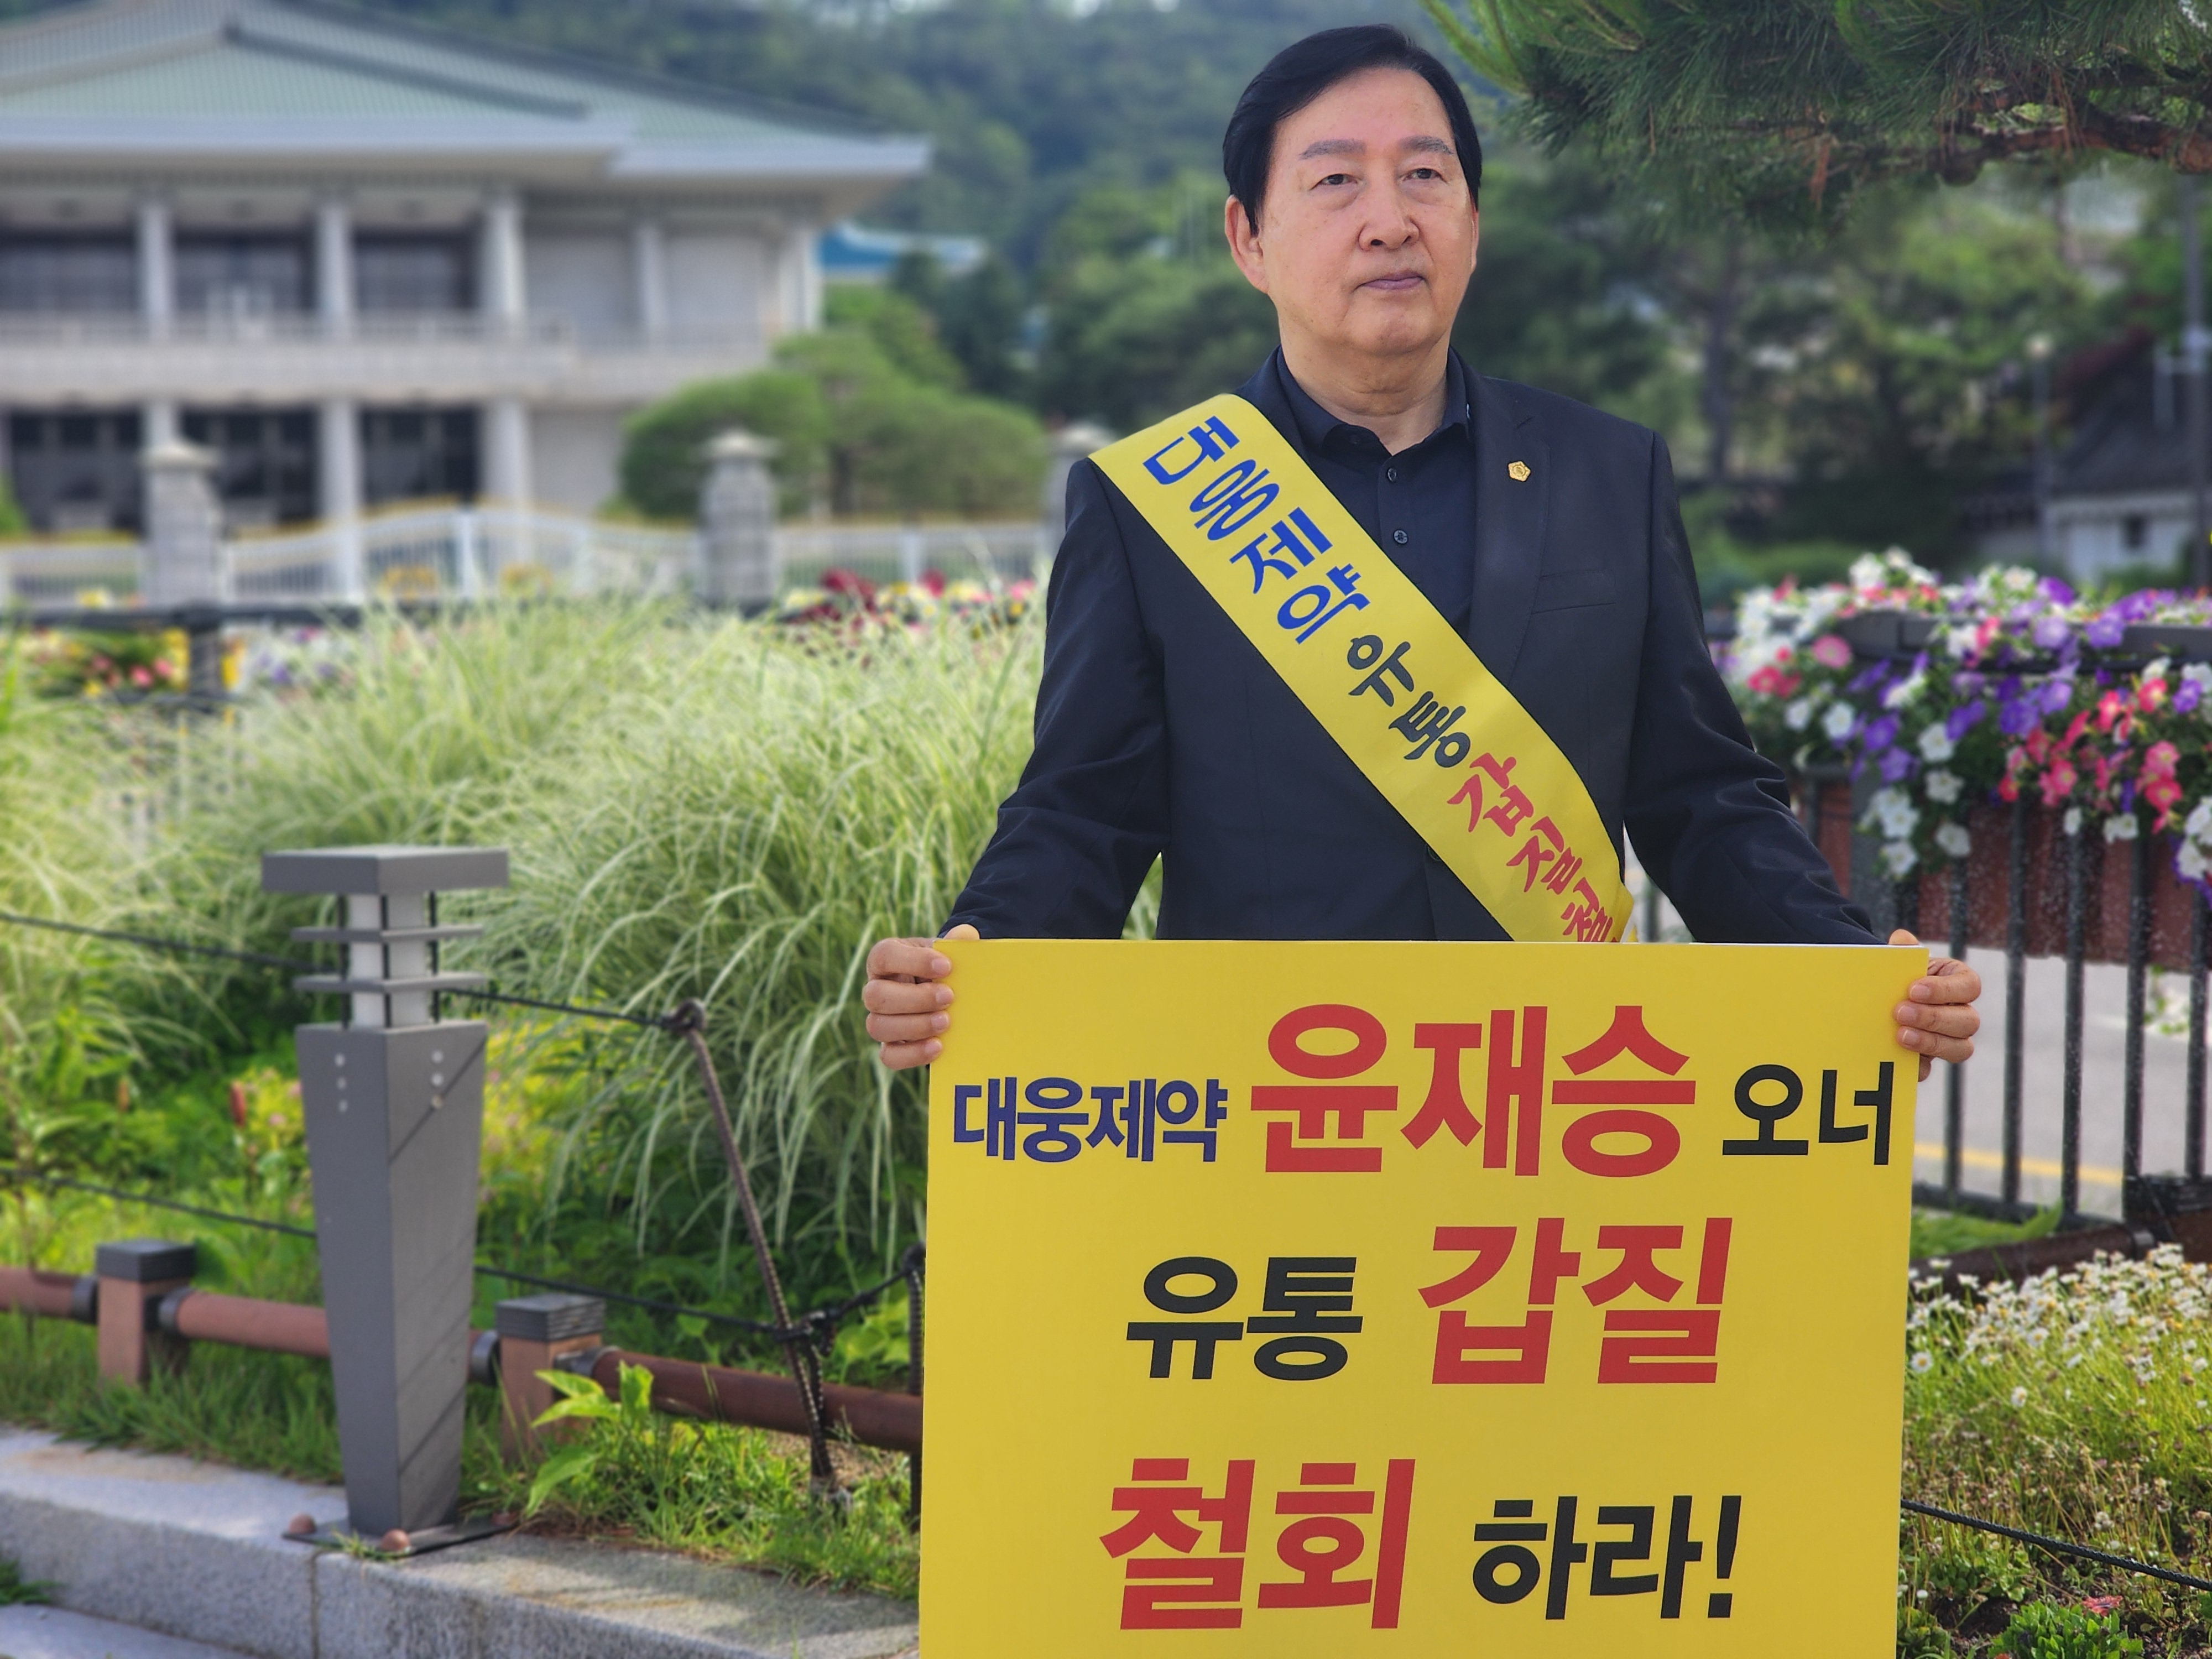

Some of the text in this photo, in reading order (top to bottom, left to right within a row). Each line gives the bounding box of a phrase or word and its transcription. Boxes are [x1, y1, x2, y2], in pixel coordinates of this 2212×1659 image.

[1142, 416, 1618, 942] 대웅제약 유통 갑질철
[953, 1003, 1895, 1178] 대웅제약 윤재승 오너
[1126, 1217, 1733, 1385] 유통 갑질
[1099, 1458, 1742, 1631] 철회 하라!
